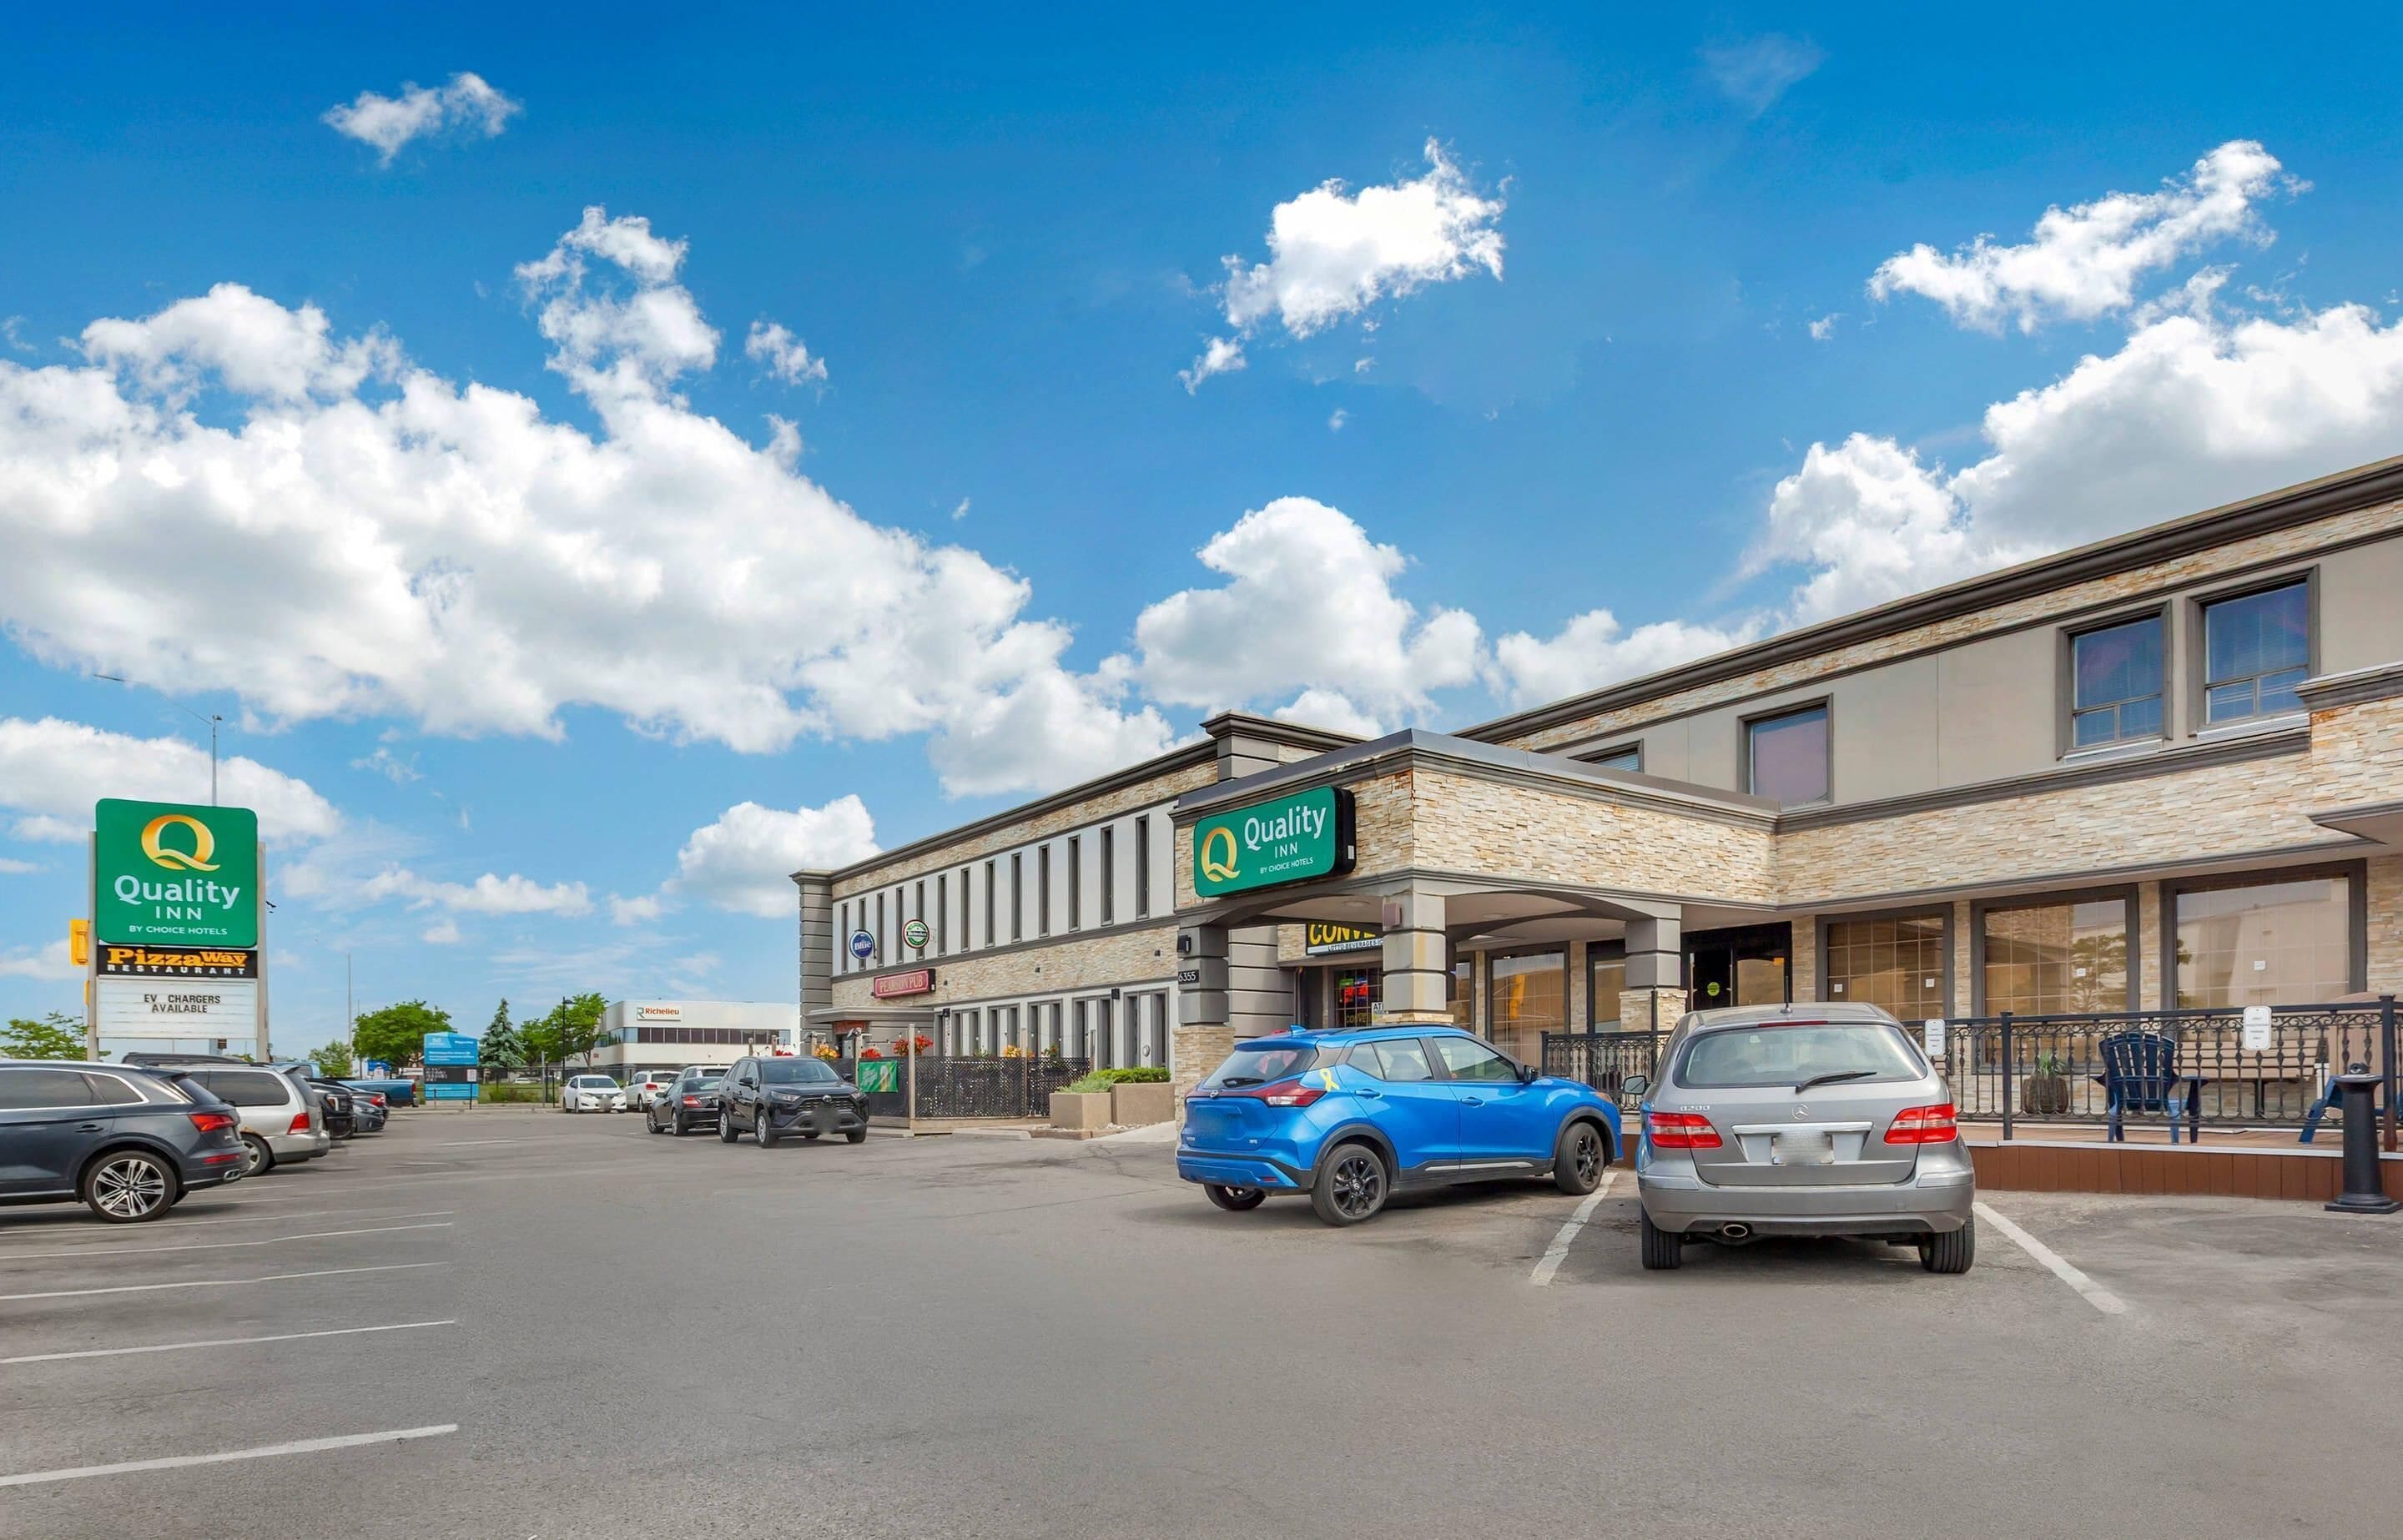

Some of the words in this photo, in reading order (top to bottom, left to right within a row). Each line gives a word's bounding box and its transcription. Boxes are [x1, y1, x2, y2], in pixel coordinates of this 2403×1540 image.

[1244, 805, 1327, 851] Quality
[141, 814, 221, 872] Q
[1275, 842, 1298, 858] INN
[1201, 827, 1241, 882] Q
[1260, 866, 1267, 874] BY
[1268, 862, 1291, 873] CHOICE
[1292, 857, 1314, 868] HOTELS
[114, 875, 240, 909] Quality
[156, 906, 202, 920] INN
[1310, 924, 1376, 945] CON
[854, 941, 871, 950] Blue
[107, 964, 245, 974] RESTAURANT
[909, 974, 924, 989] PUB
[1178, 972, 1196, 982] 6355
[144, 994, 158, 1003] EV
[168, 994, 221, 1004] CHARGERS
[152, 1004, 208, 1014] AVAILABLE
[645, 1007, 680, 1015] Richelieu
